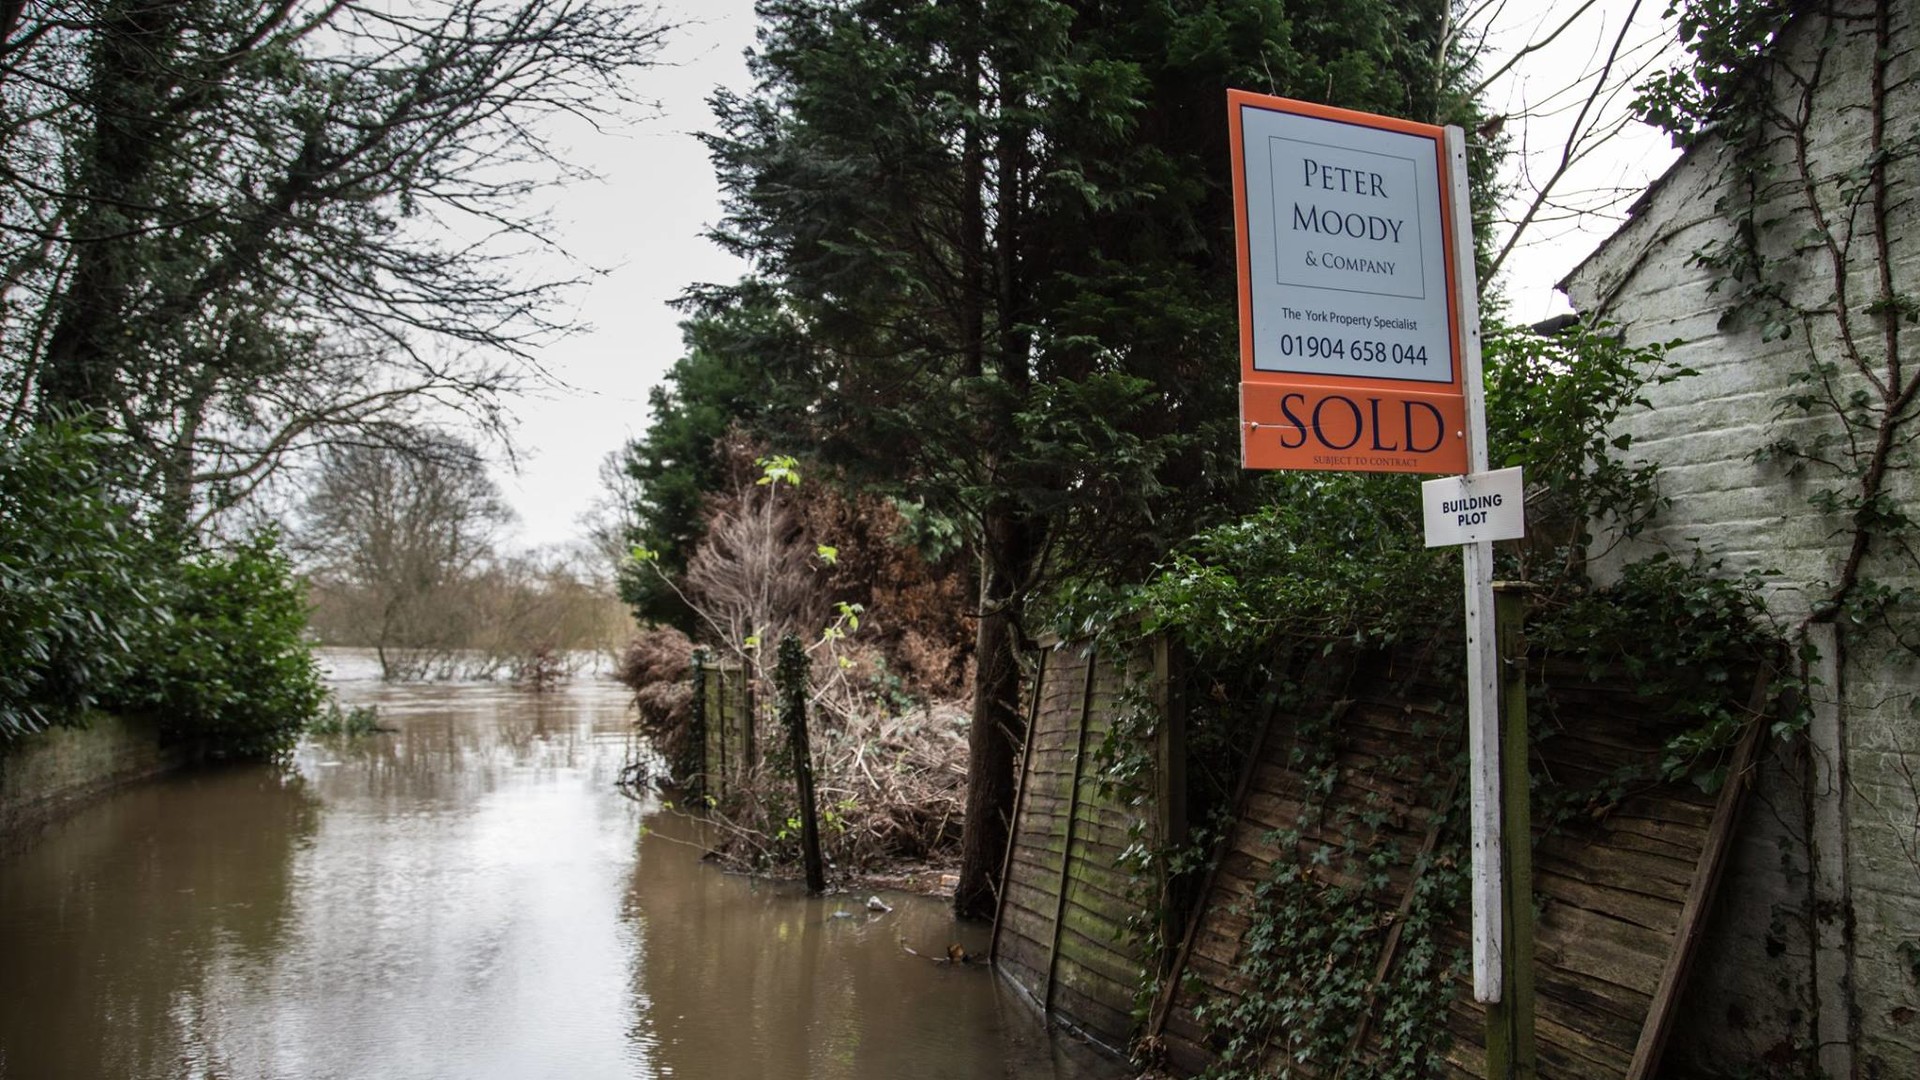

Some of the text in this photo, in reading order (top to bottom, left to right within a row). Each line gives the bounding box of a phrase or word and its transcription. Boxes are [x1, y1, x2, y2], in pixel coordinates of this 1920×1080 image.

[1303, 158, 1388, 198] PETER
[1292, 202, 1403, 243] MOODY
[1305, 250, 1395, 275] & COMPANY
[1281, 307, 1417, 331] The York Property Specialist
[1280, 334, 1428, 366] 01904 658 044
[1280, 393, 1445, 453] SOLD
[1313, 455, 1418, 467] SUBJECT TO CONTRACT
[1442, 494, 1502, 514] BUILDING
[1458, 511, 1487, 526] PLOT
